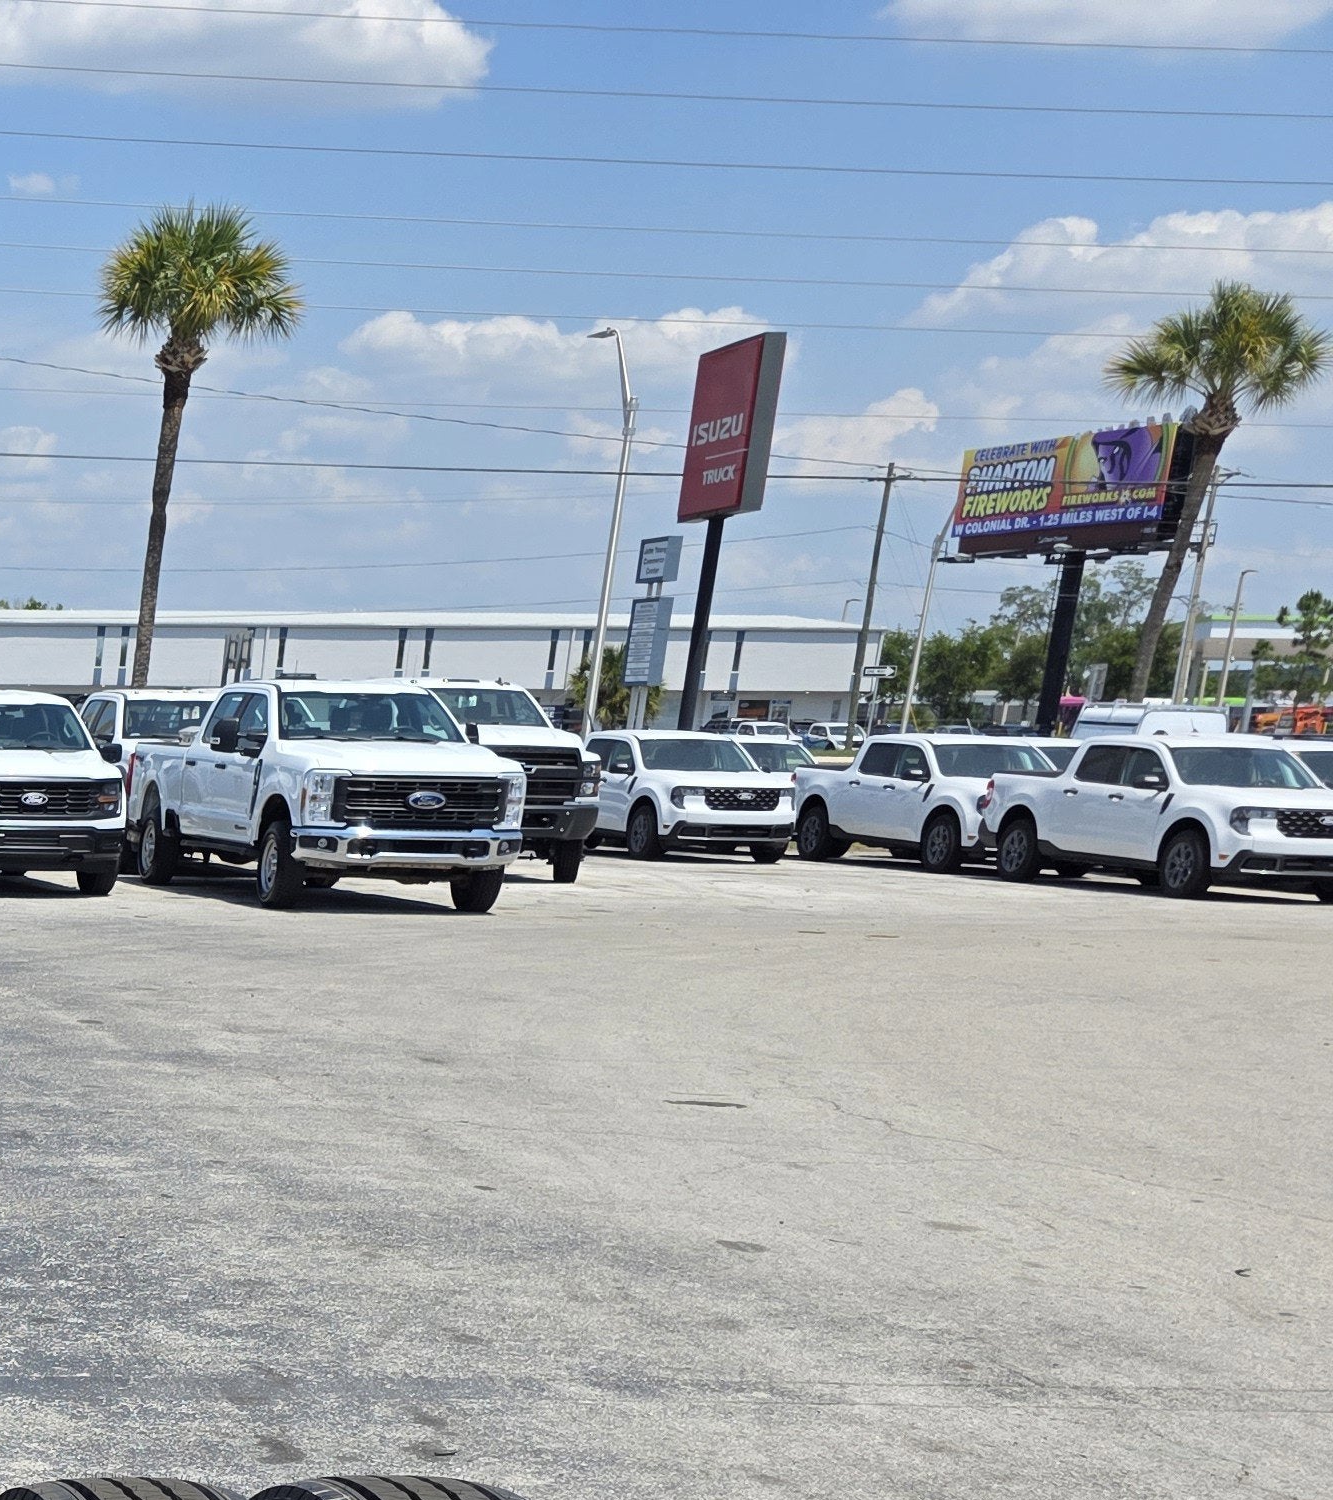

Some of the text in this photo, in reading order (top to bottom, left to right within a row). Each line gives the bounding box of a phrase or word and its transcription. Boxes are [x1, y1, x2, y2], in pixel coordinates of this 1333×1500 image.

[692, 413, 744, 447] ISUZU
[975, 439, 1056, 461] CELEBRATE WITH
[702, 464, 737, 486] TRUCK
[965, 456, 1056, 494] PHANTOM
[962, 486, 1052, 518] FIREWORKS
[1062, 491, 1119, 506] FIREWORKS
[954, 524, 965, 535] W
[965, 519, 1012, 534] COLONIAL
[1014, 516, 1030, 529] DR.
[1039, 513, 1060, 527] 1.25
[1061, 510, 1093, 525] MILES
[1095, 507, 1125, 522] WEST
[1126, 506, 1142, 519] OF
[1143, 505, 1158, 519] I-4
